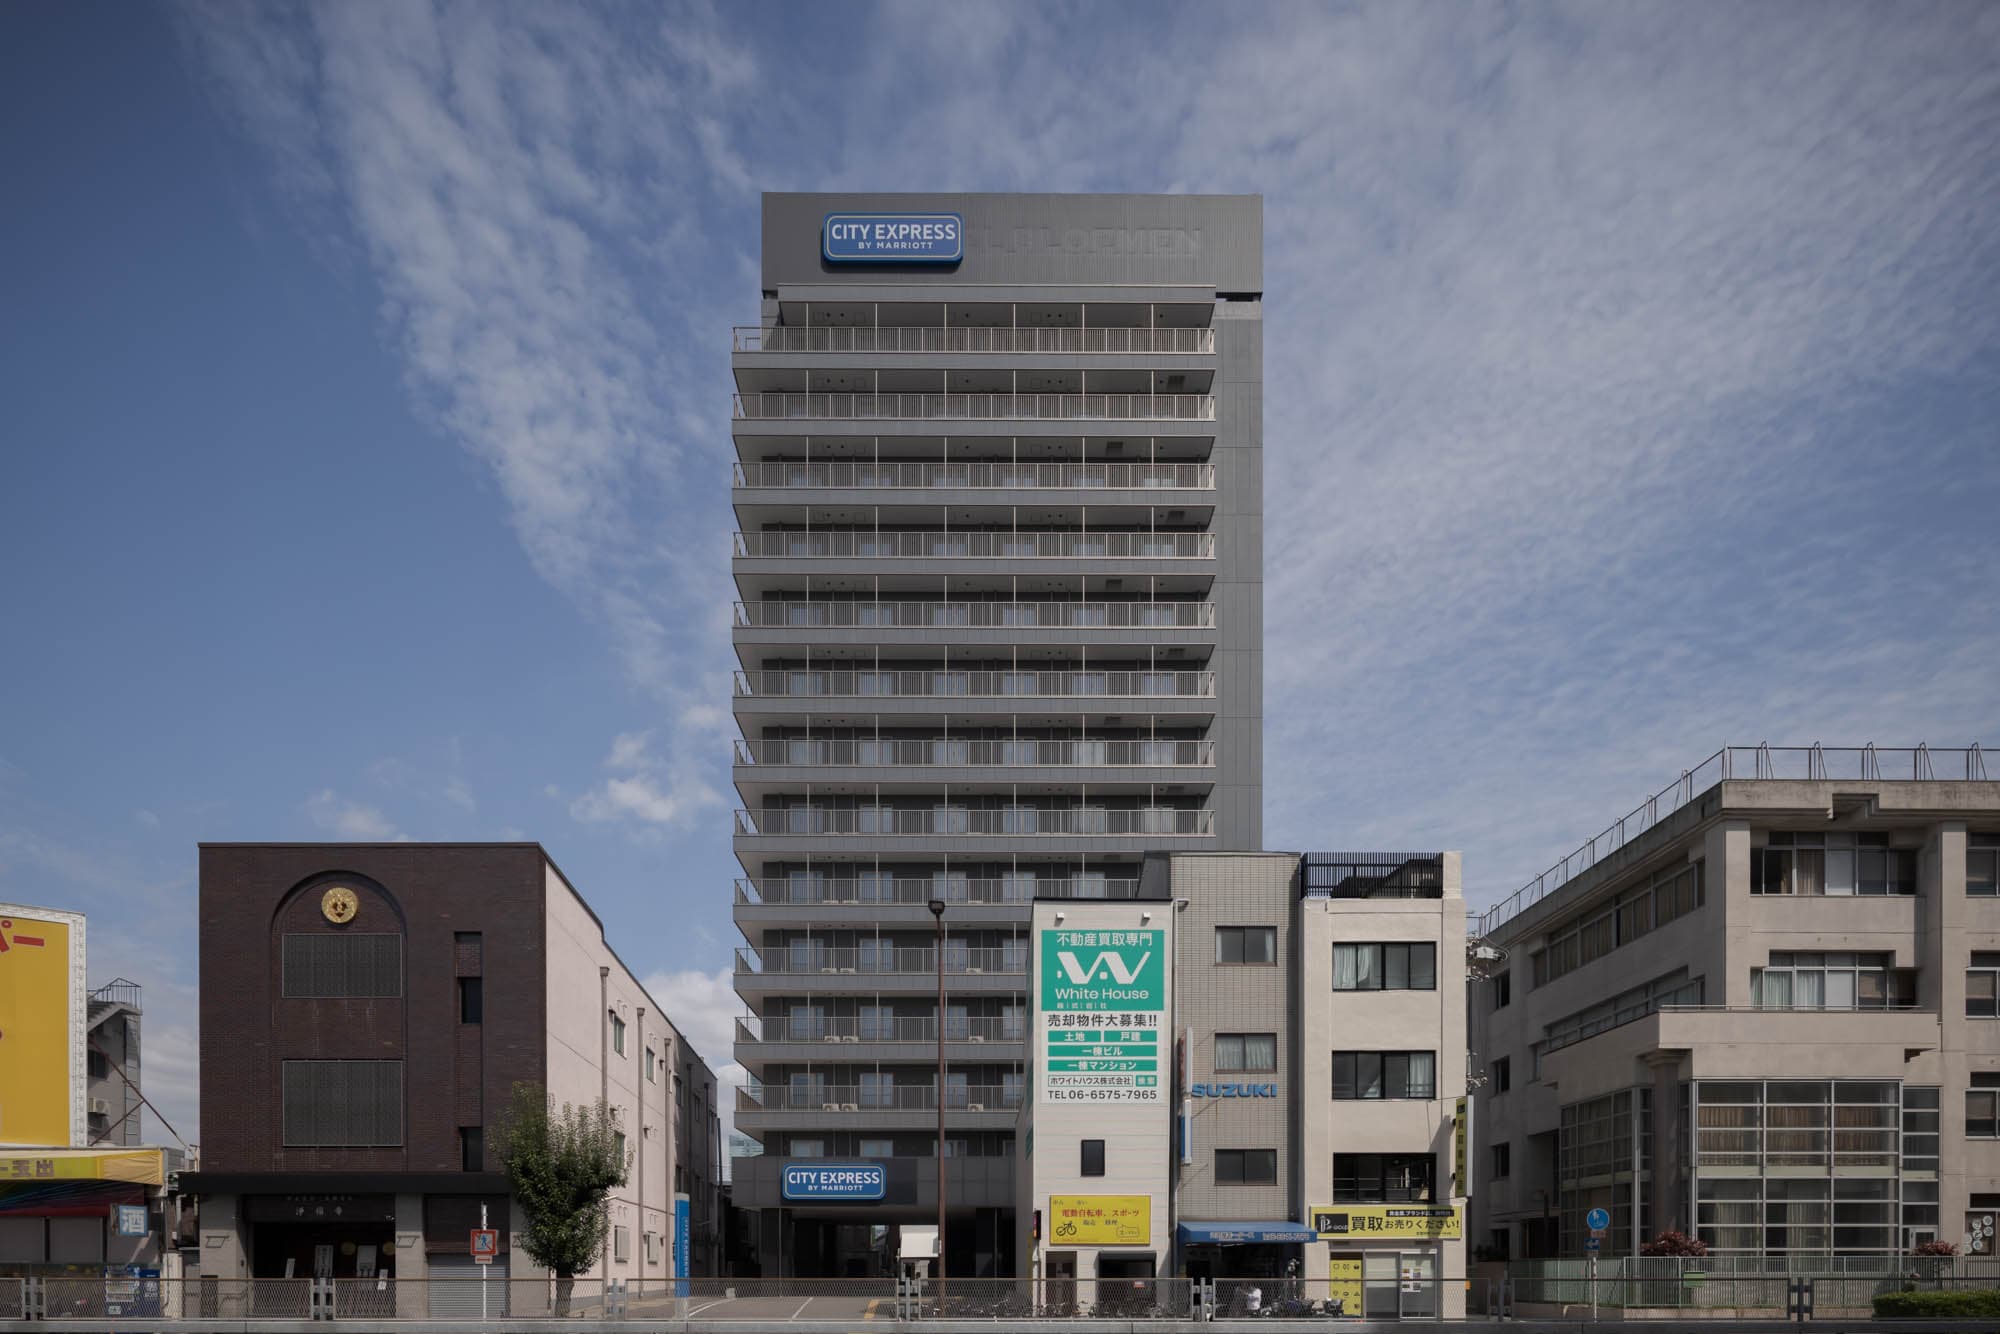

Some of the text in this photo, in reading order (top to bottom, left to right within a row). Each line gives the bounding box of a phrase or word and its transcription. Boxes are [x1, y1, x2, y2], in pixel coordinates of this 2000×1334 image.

[831, 224, 956, 240] CITY EXPRESS
[1056, 932, 1153, 947] 不動産買取専門
[1055, 988, 1149, 1000] White House
[1047, 1014, 1157, 1028] 売却物件大募集!!
[1064, 1032, 1085, 1042] 土地
[1050, 1077, 1131, 1085] ホワイトハウス株式会社
[1047, 1090, 1157, 1100] TEL 06-6575-7965
[1191, 1083, 1278, 1098] SUZUKI
[788, 1172, 880, 1184] CITY EXPRESS
[122, 1206, 146, 1234] 酒
[1351, 1216, 1384, 1232] 買取
